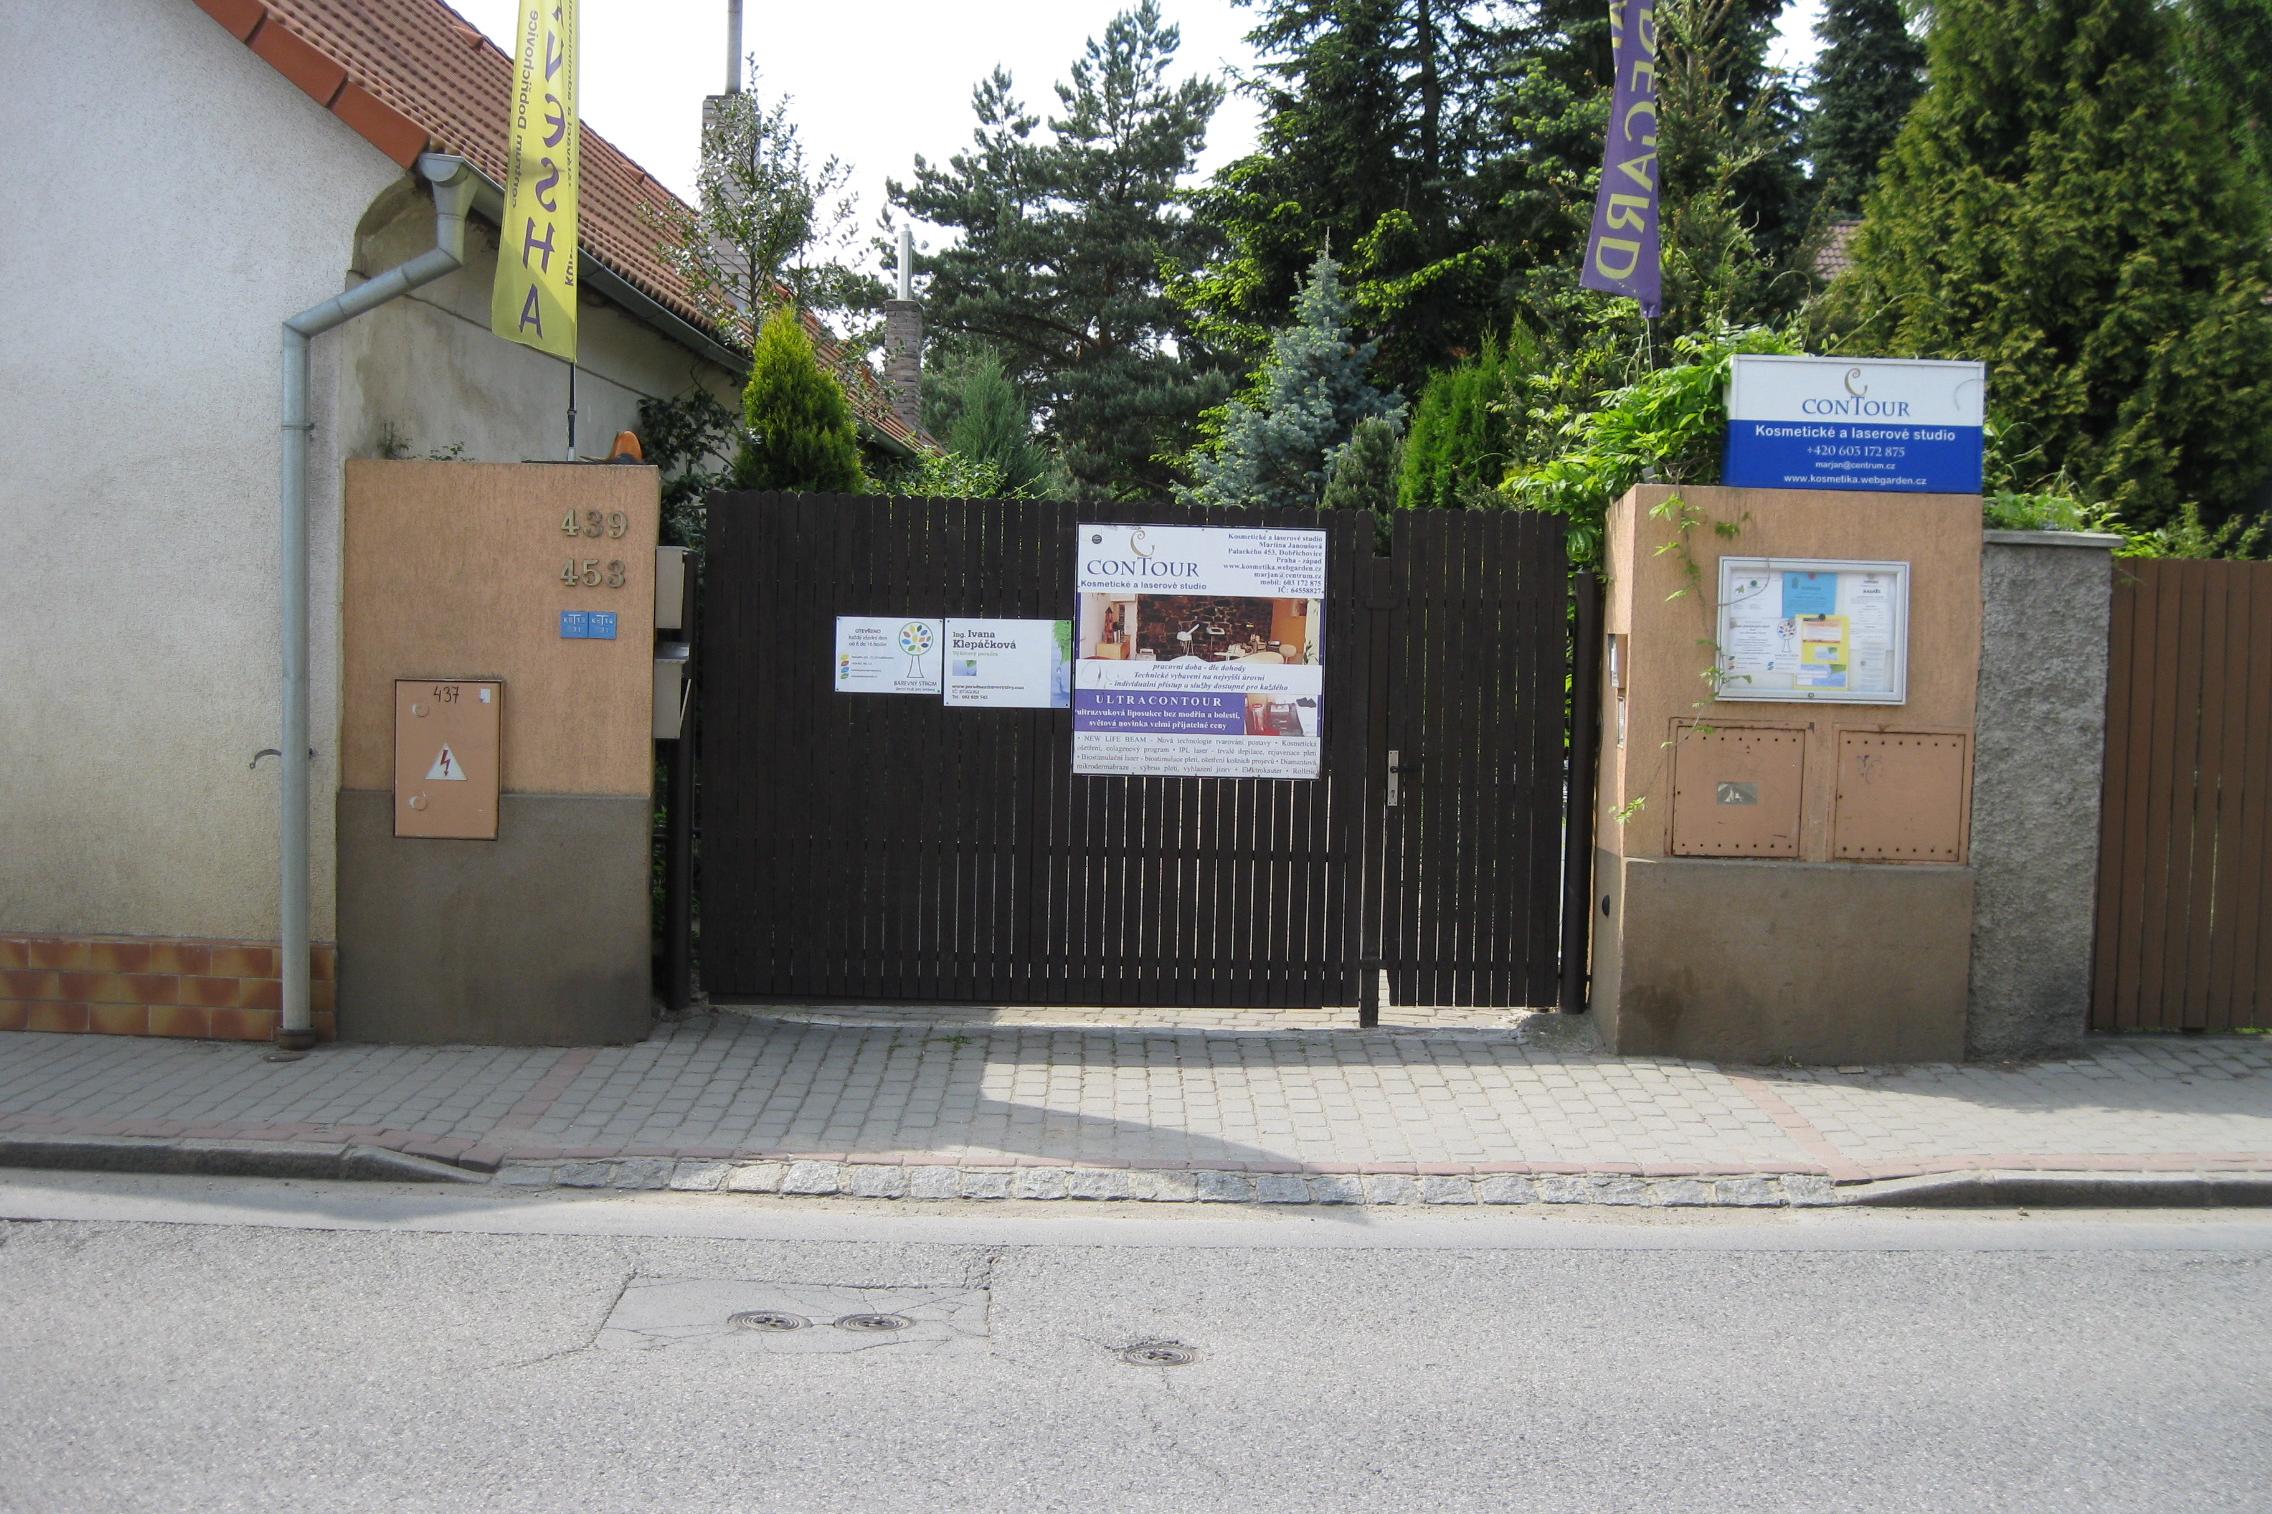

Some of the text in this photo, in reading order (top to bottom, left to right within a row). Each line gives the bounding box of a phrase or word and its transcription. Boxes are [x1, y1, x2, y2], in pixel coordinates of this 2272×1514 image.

[1802, 395, 1911, 418] CONTOUR
[1755, 424, 1956, 441] Kosmetické a laserové studio
[1807, 445, 1906, 458] +420 603 172 875
[1815, 460, 1896, 471] marjan@centrum.cz
[1784, 474, 1927, 486] www.kosmetika.webgarden.cz
[560, 509, 628, 539] 439
[560, 558, 626, 588] 453
[1087, 557, 1200, 578] CONTOUR
[1080, 579, 1131, 589] Kosmetické
[1141, 581, 1178, 589] laserové
[1180, 582, 1207, 590] studio
[968, 630, 995, 638] Ivana
[953, 640, 1016, 650] Klepáčková
[433, 686, 460, 703] 437
[1096, 695, 1222, 707] ULTRACONTOUR
[1127, 709, 1162, 718] liposukce
